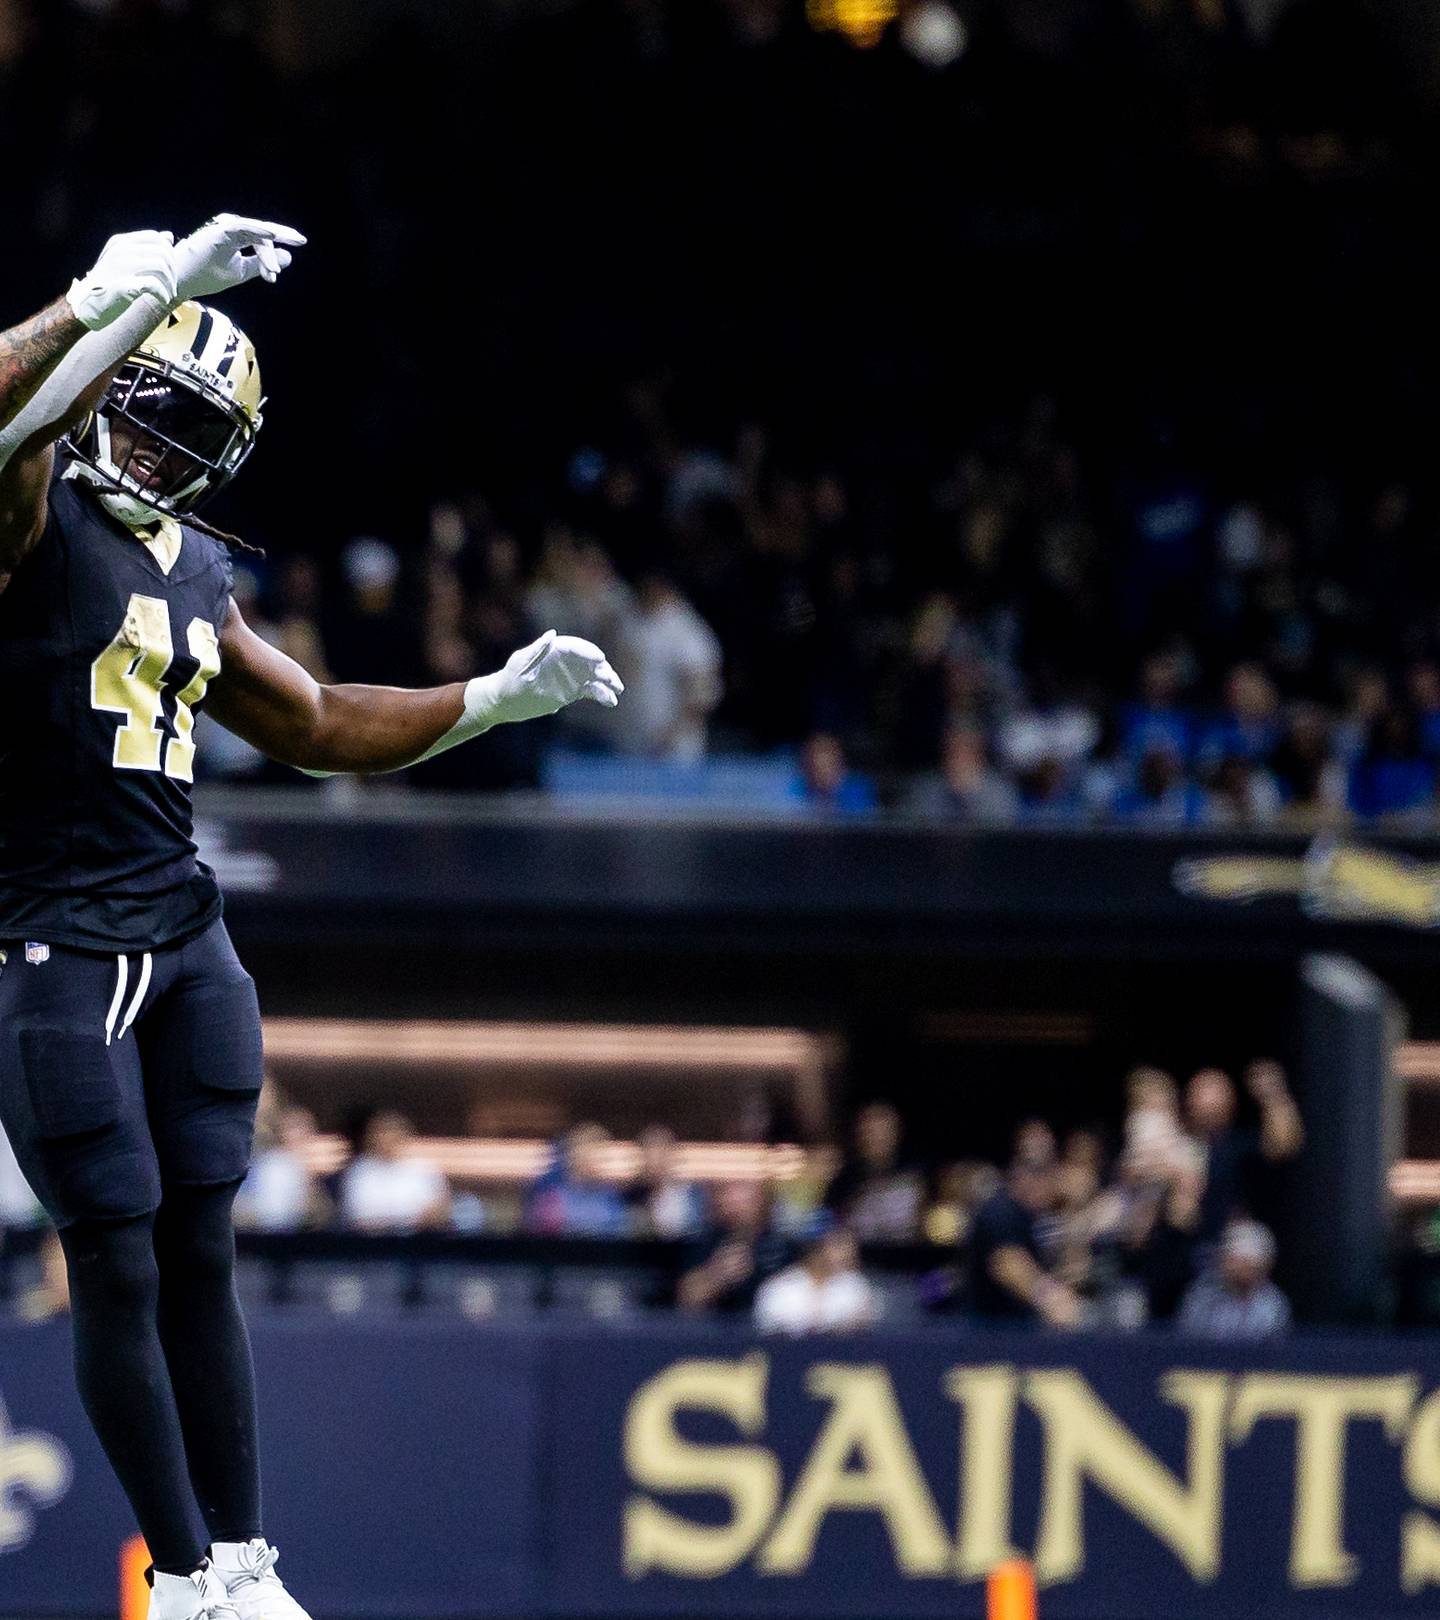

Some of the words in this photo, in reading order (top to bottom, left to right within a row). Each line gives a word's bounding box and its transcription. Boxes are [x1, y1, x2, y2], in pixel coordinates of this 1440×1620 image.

[189, 363, 221, 387] SAINTS
[90, 594, 221, 784] 41
[621, 1350, 1440, 1594] SAINT
